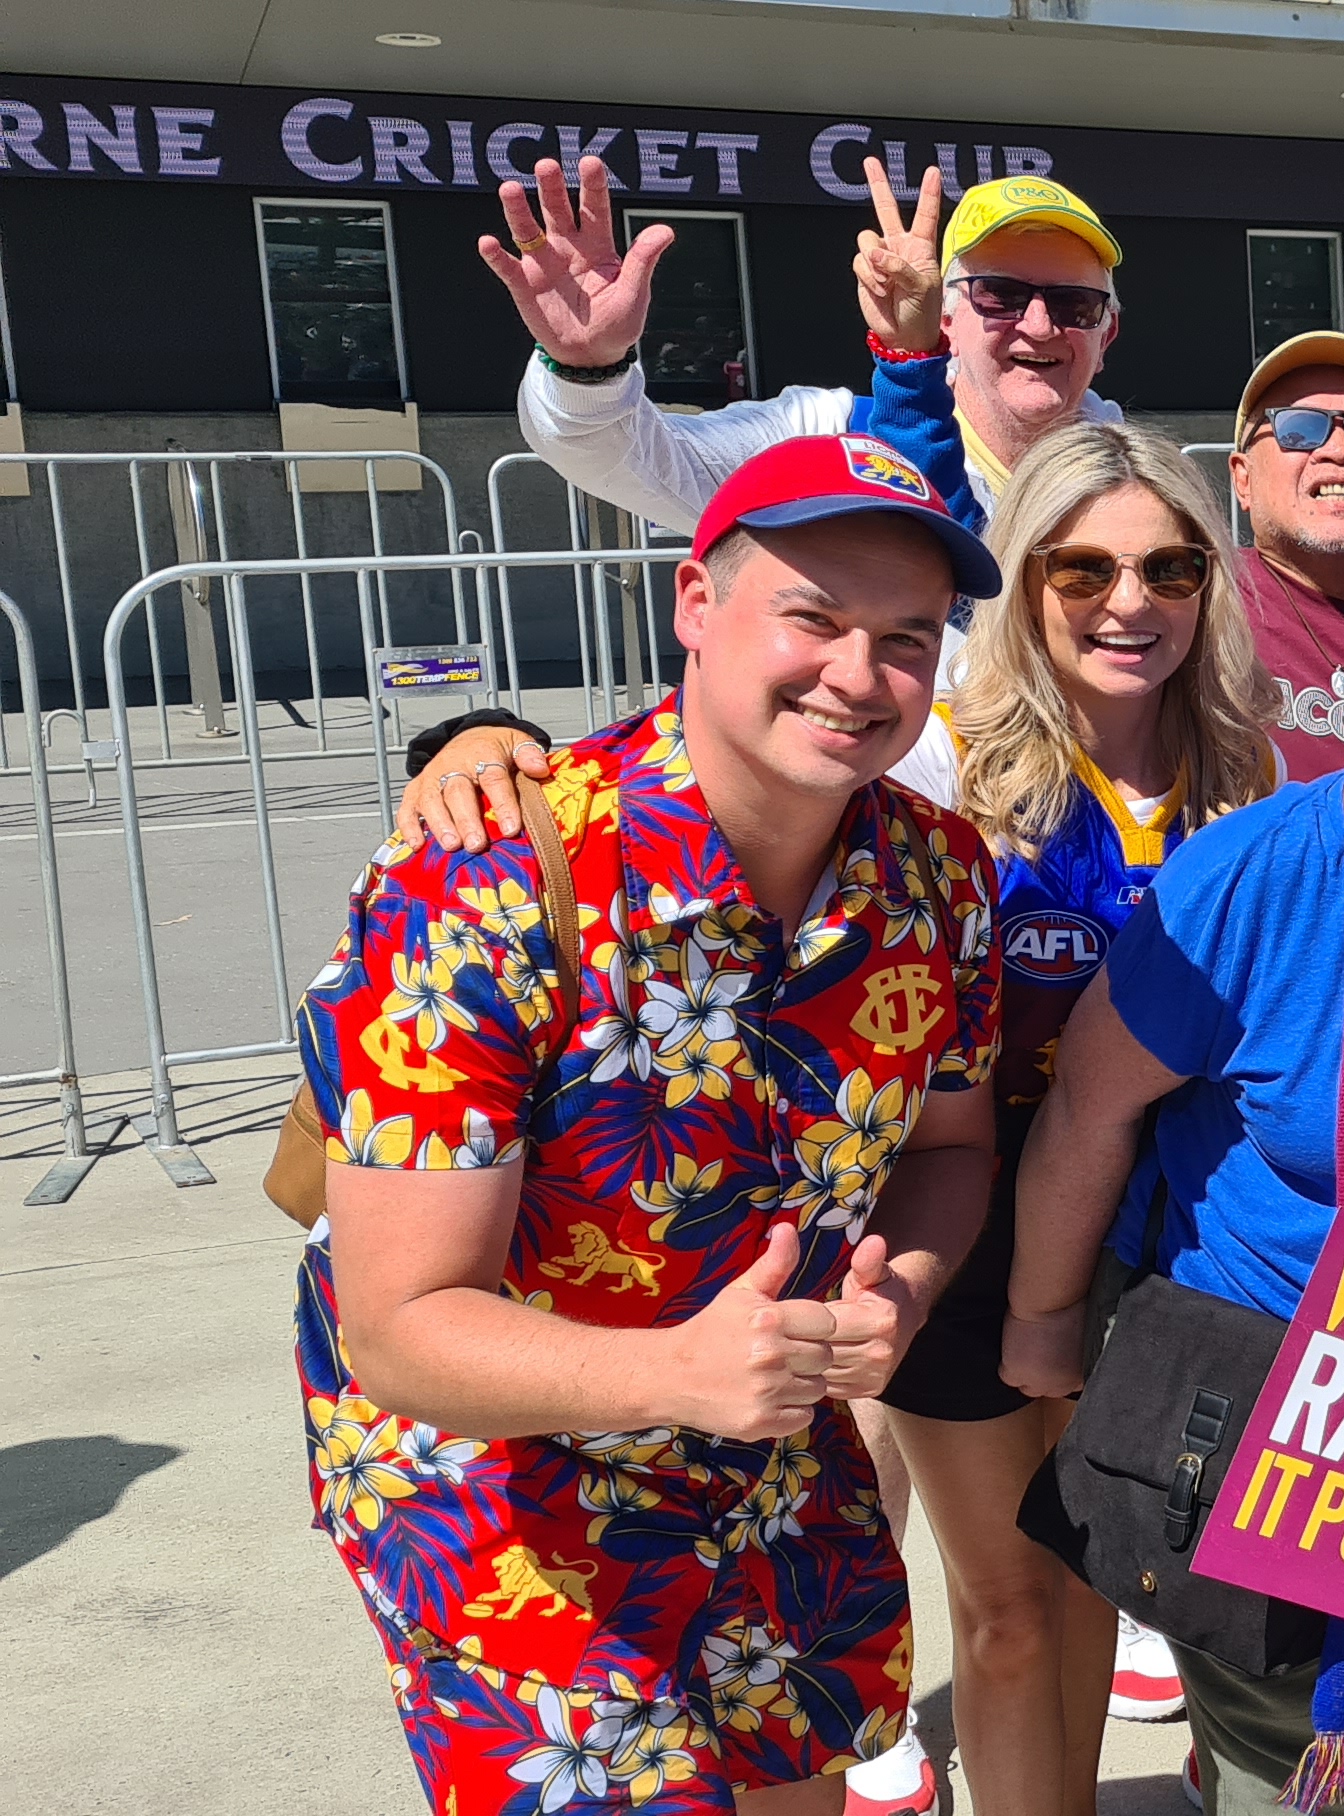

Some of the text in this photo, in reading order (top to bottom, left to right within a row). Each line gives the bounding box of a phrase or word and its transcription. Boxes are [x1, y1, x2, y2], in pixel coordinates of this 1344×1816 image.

[280, 97, 760, 195] CRICKET
[809, 123, 1054, 201] CLUB
[1010, 187, 1060, 201] P&O
[1005, 926, 1099, 961] AFL
[1233, 1450, 1311, 1538] IT
